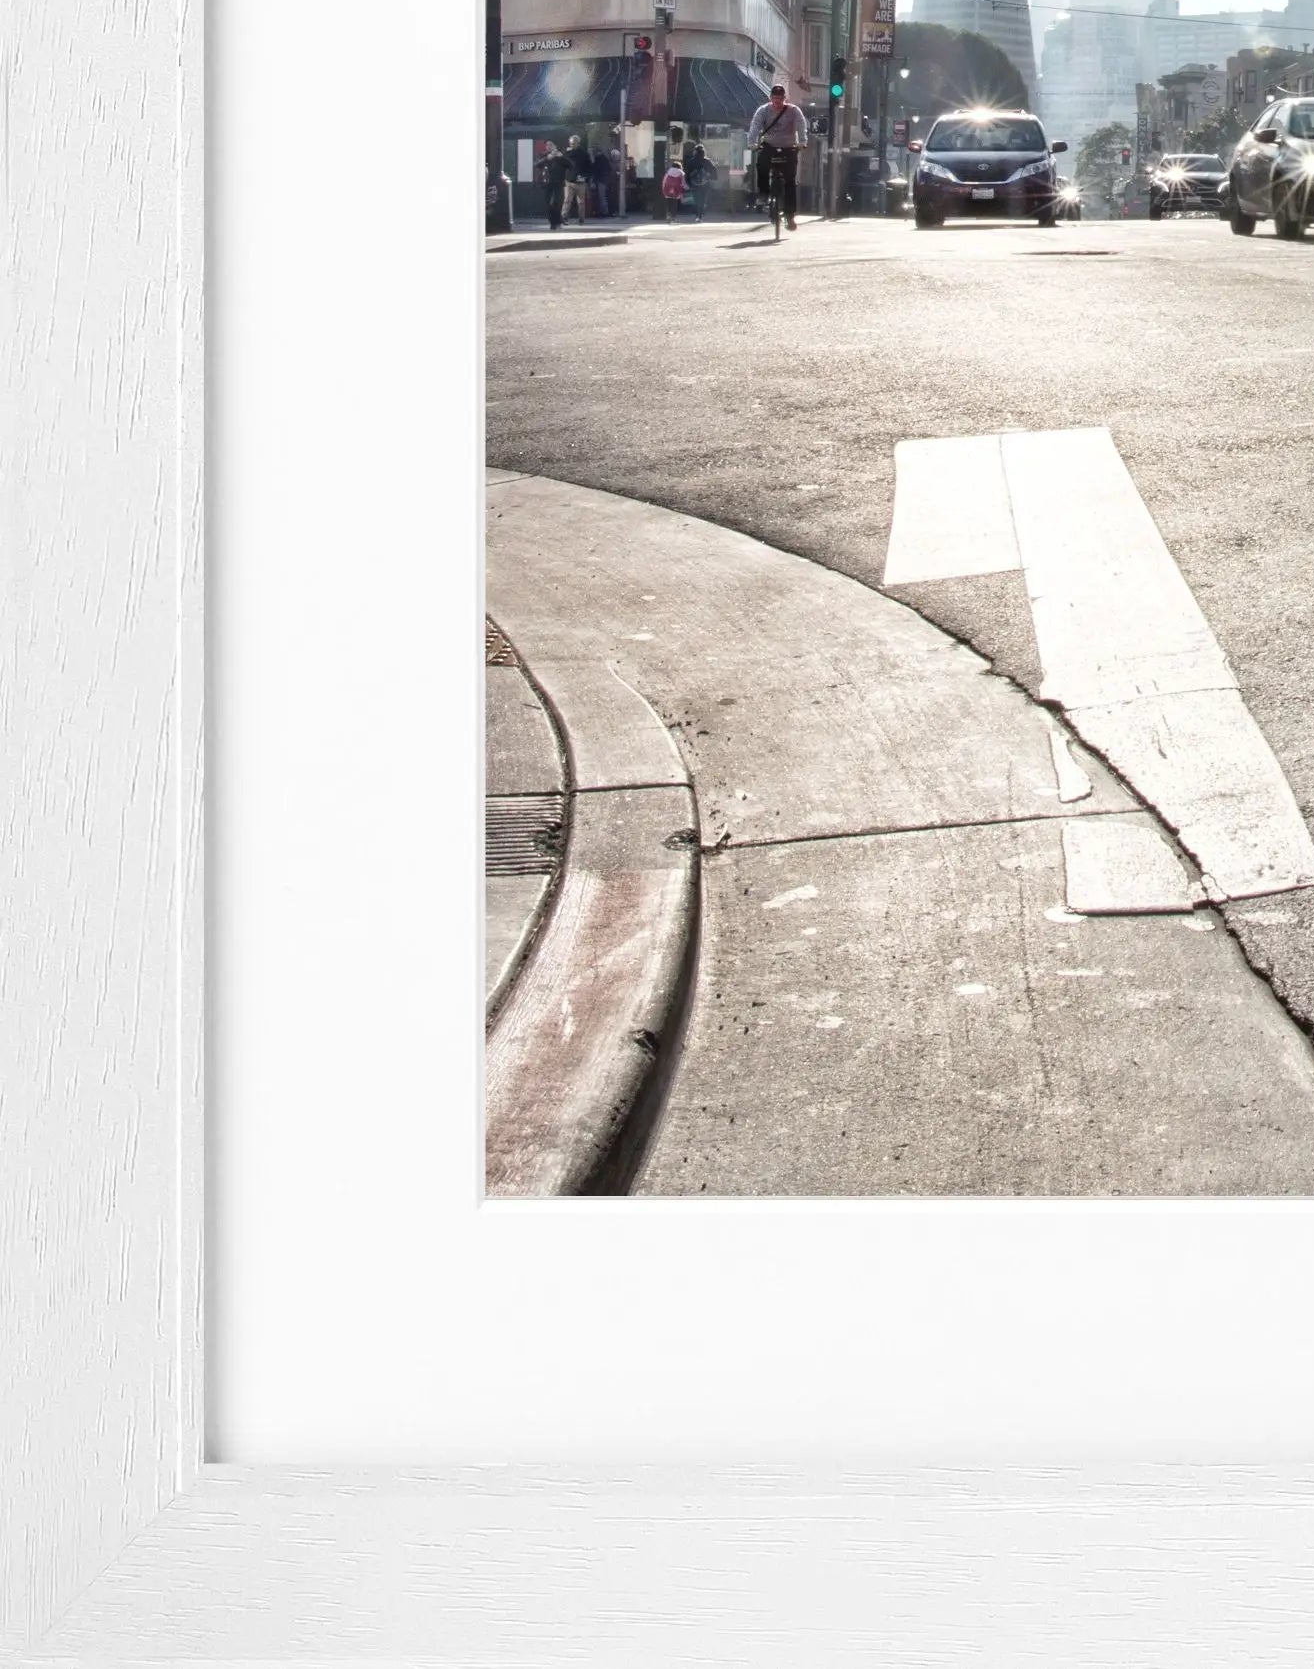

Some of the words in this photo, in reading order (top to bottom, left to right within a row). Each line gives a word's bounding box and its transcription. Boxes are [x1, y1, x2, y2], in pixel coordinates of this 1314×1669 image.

[875, 11, 893, 22] ARE
[518, 42, 535, 51] BNP
[536, 39, 570, 50] PARIBAS
[862, 43, 891, 53] SFMADE
